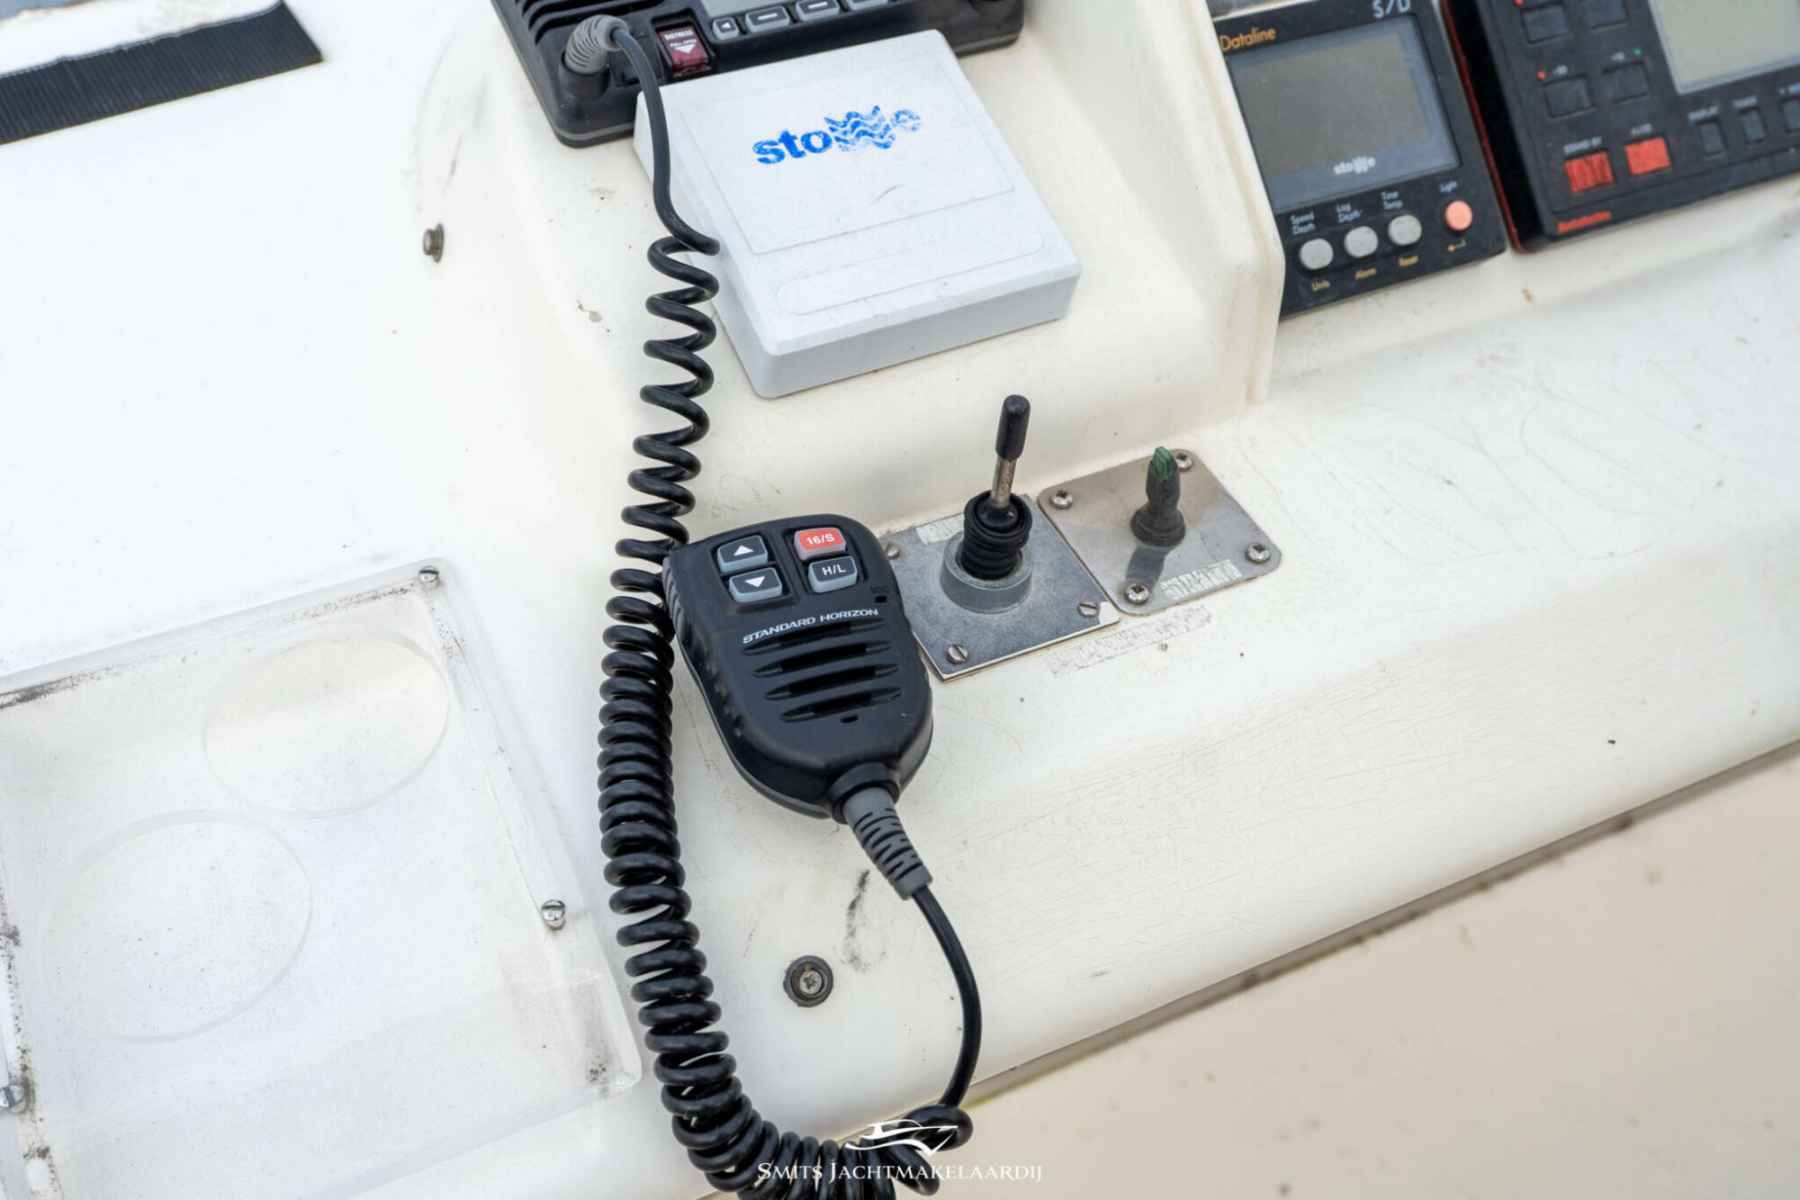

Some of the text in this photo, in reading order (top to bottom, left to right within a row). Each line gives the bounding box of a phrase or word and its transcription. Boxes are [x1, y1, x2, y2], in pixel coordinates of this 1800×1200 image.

[1219, 26, 1277, 51] Dataline
[805, 532, 835, 546] 16/S
[821, 564, 847, 576] H/L
[742, 608, 880, 645] STANDARD HORIZON
